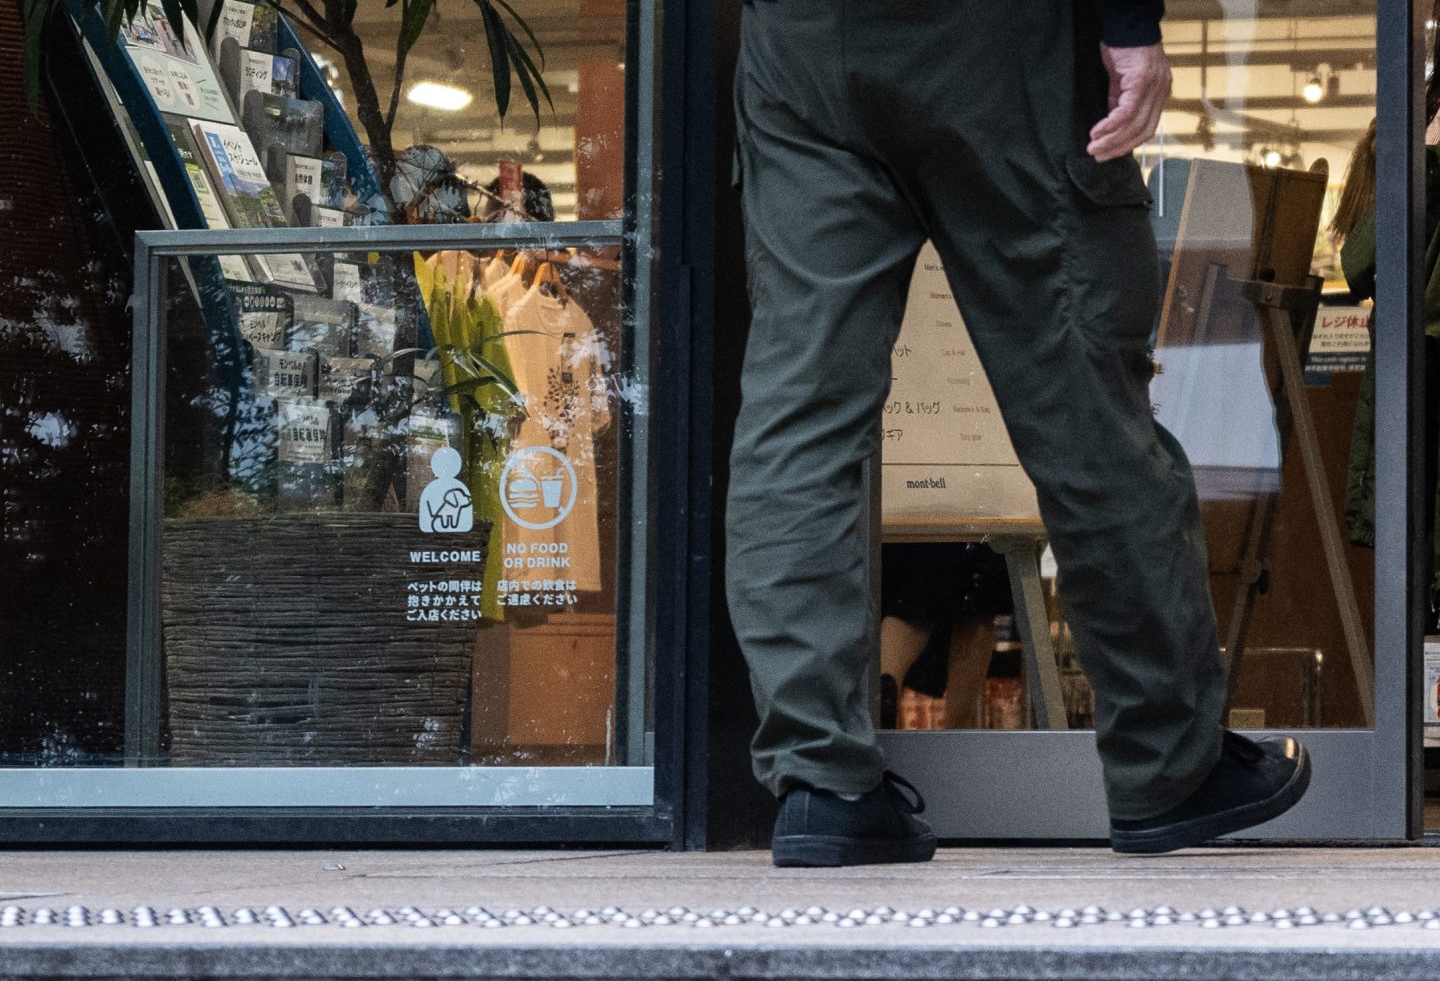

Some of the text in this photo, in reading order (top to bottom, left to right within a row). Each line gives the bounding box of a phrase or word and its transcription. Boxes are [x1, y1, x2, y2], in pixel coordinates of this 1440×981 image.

[506, 542, 568, 554] NO FOOD
[409, 550, 481, 563] WELCOME
[503, 557, 570, 568] OR DRINK
[407, 580, 482, 592] ペットの同伴は
[497, 579, 577, 591] 店内での飲食は
[407, 594, 481, 607] 抱きかかえて
[496, 593, 578, 606] ご遠慮ください
[406, 608, 482, 622] ご入店ください
